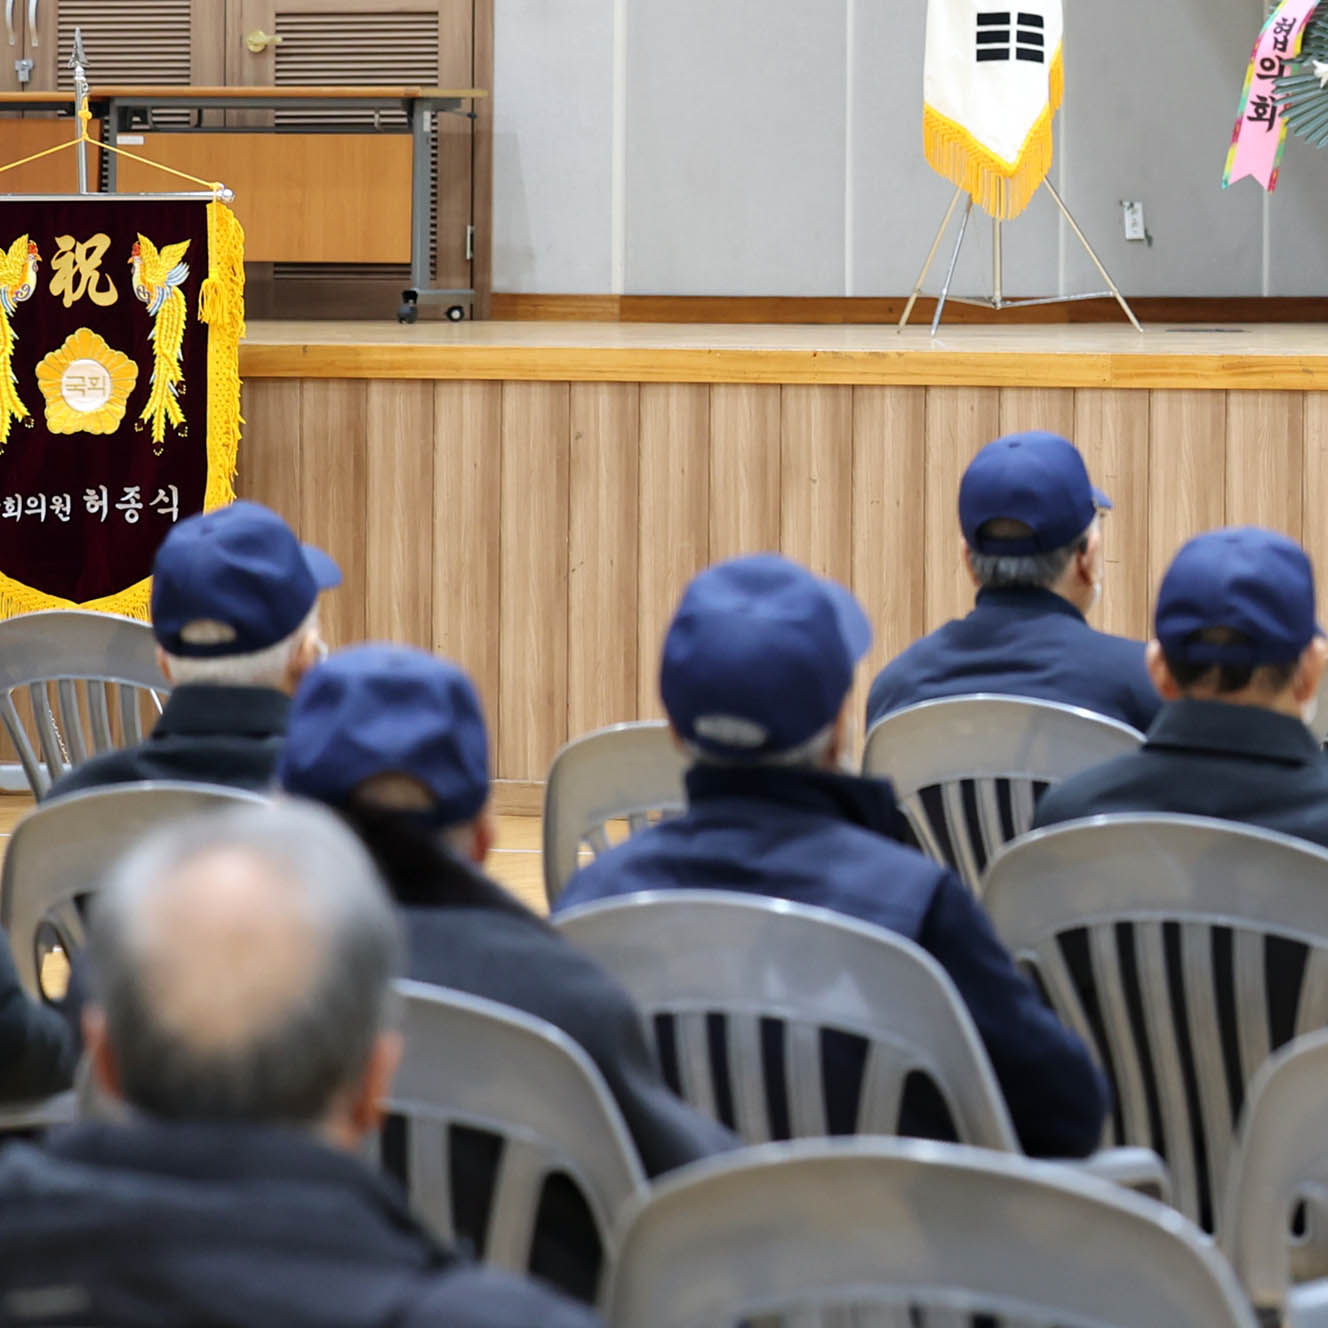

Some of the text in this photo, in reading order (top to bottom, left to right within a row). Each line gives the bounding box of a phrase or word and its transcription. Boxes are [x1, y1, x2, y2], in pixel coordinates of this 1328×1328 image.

[1247, 17, 1297, 133] 협의회
[48, 232, 119, 309] 祝
[65, 375, 107, 398] 국회
[0, 484, 180, 524] 회의원 허종식
